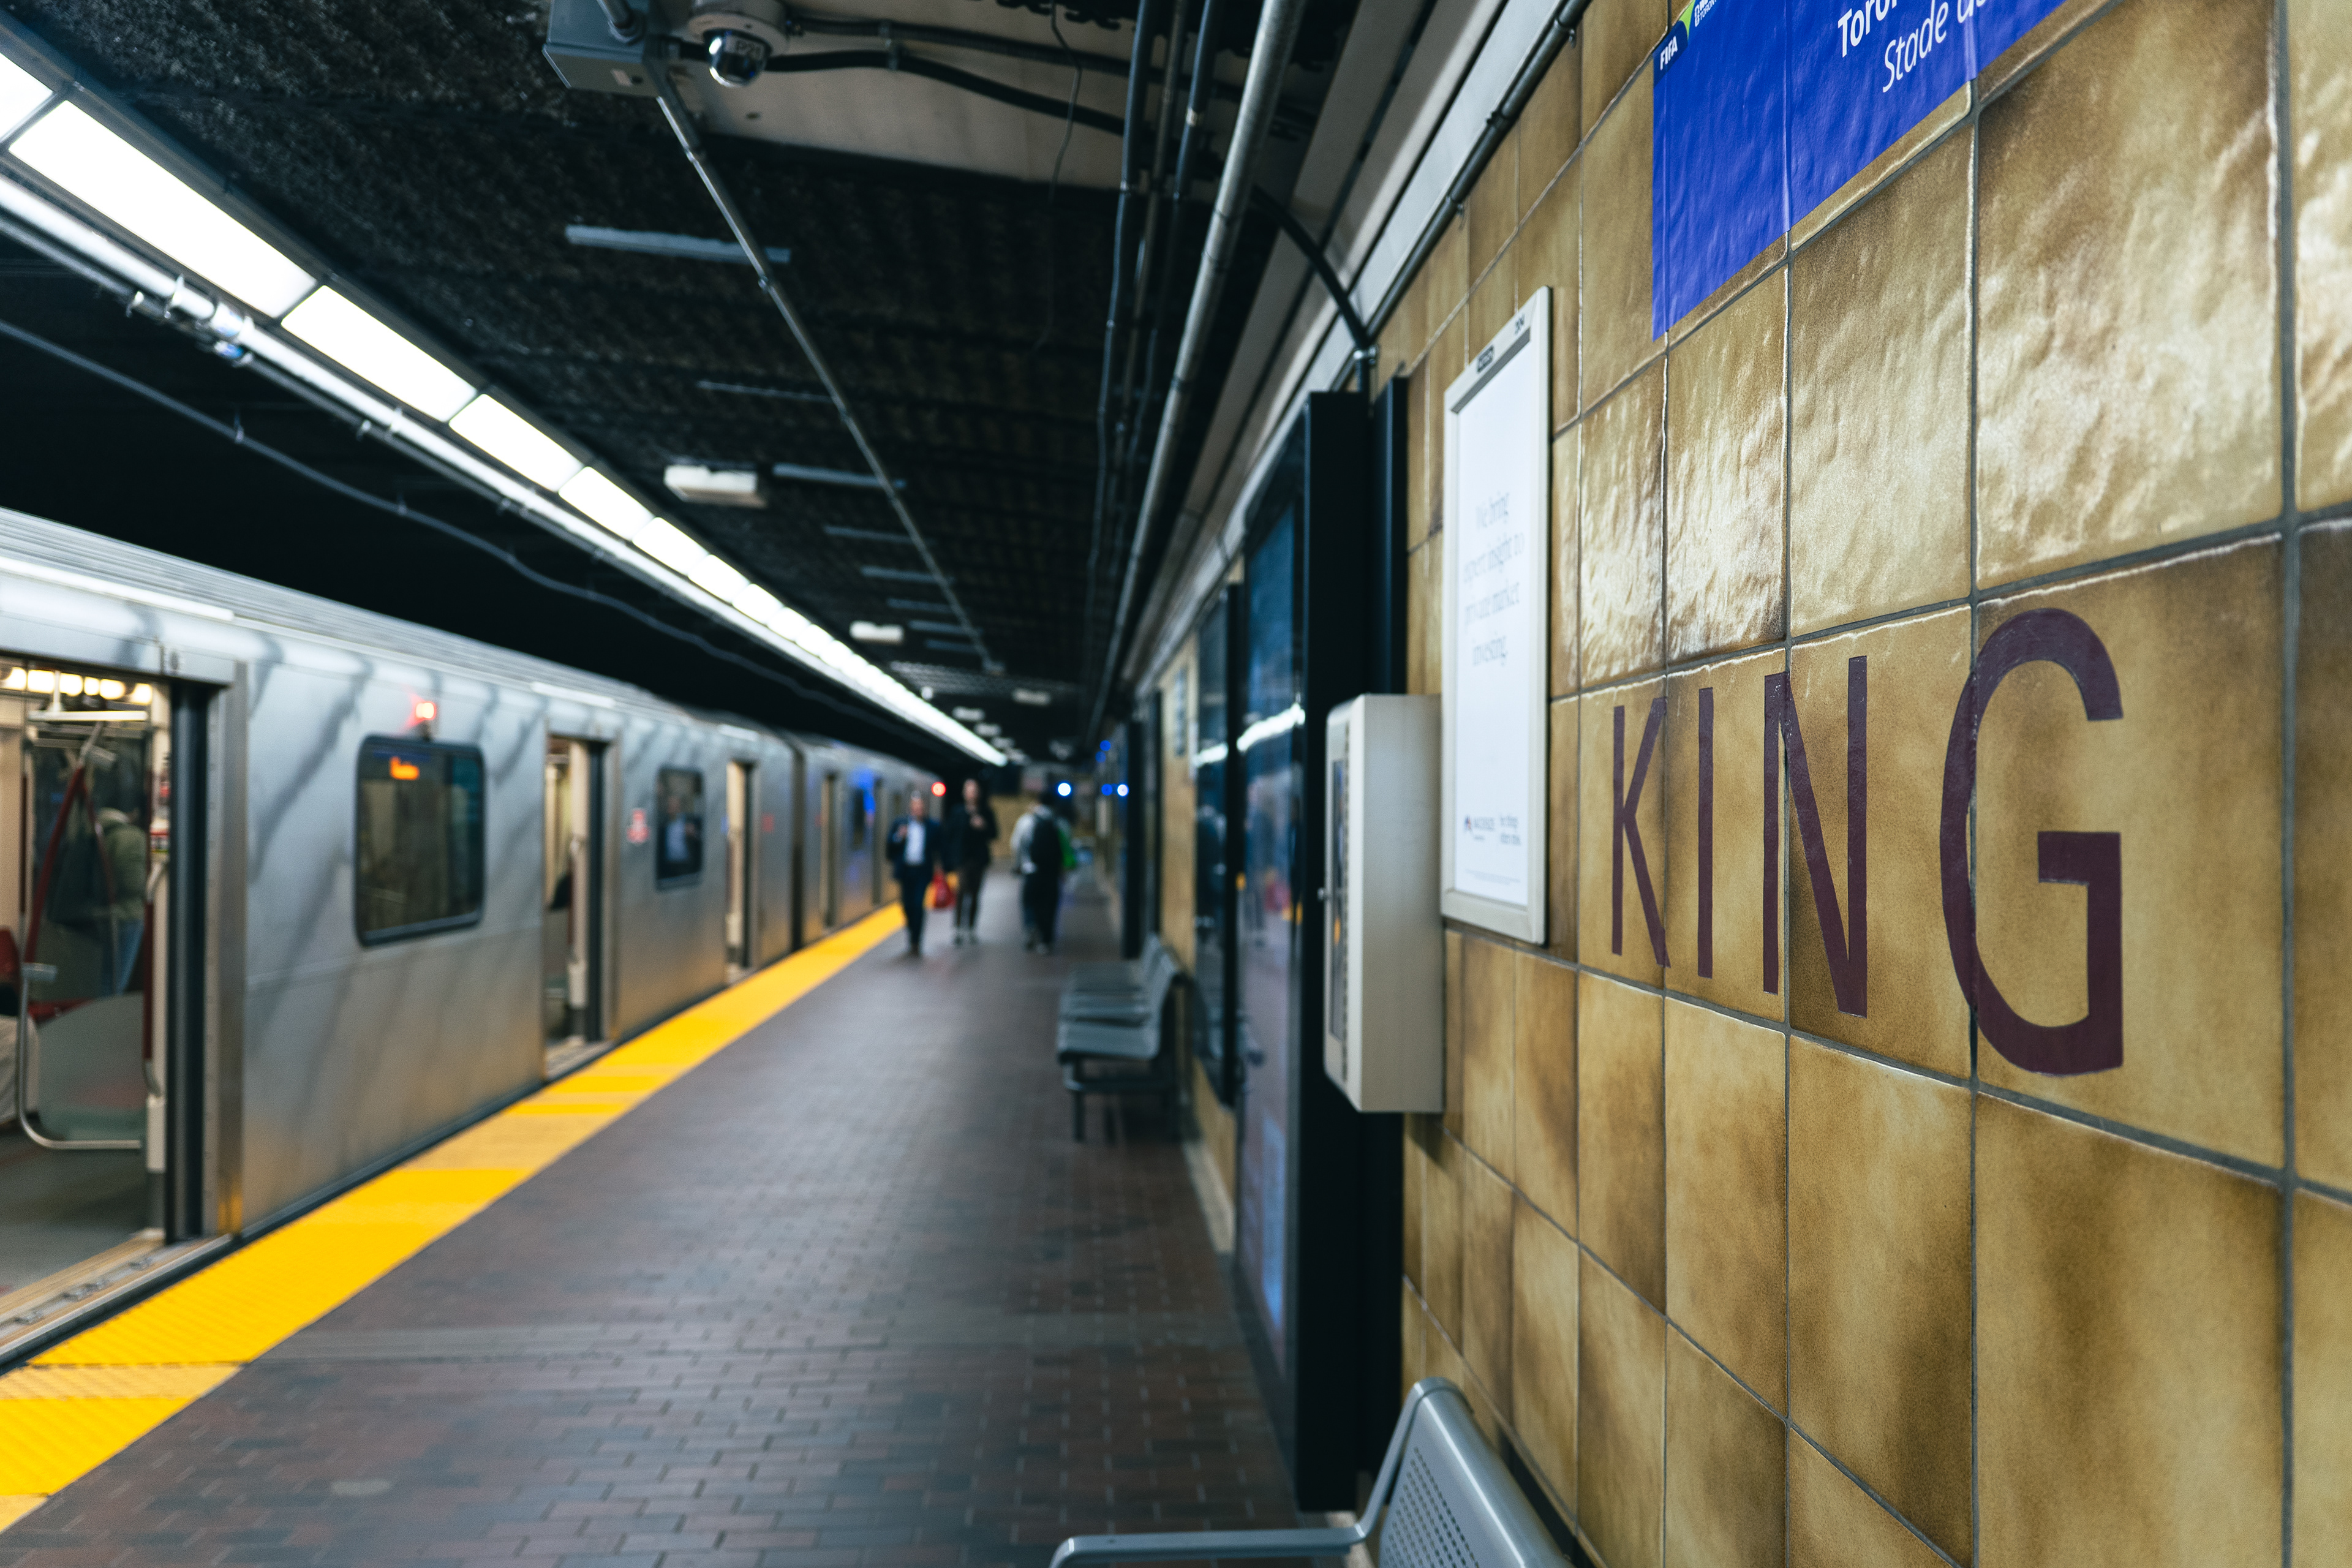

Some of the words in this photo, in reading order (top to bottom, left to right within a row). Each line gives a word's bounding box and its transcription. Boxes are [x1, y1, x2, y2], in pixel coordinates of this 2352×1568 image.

[1700, 0, 1717, 20] TORON
[1838, 0, 1897, 58] Toro
[1660, 36, 1678, 70] FIFA
[1883, 0, 1949, 92] Stade
[1612, 608, 2124, 1077] KING
